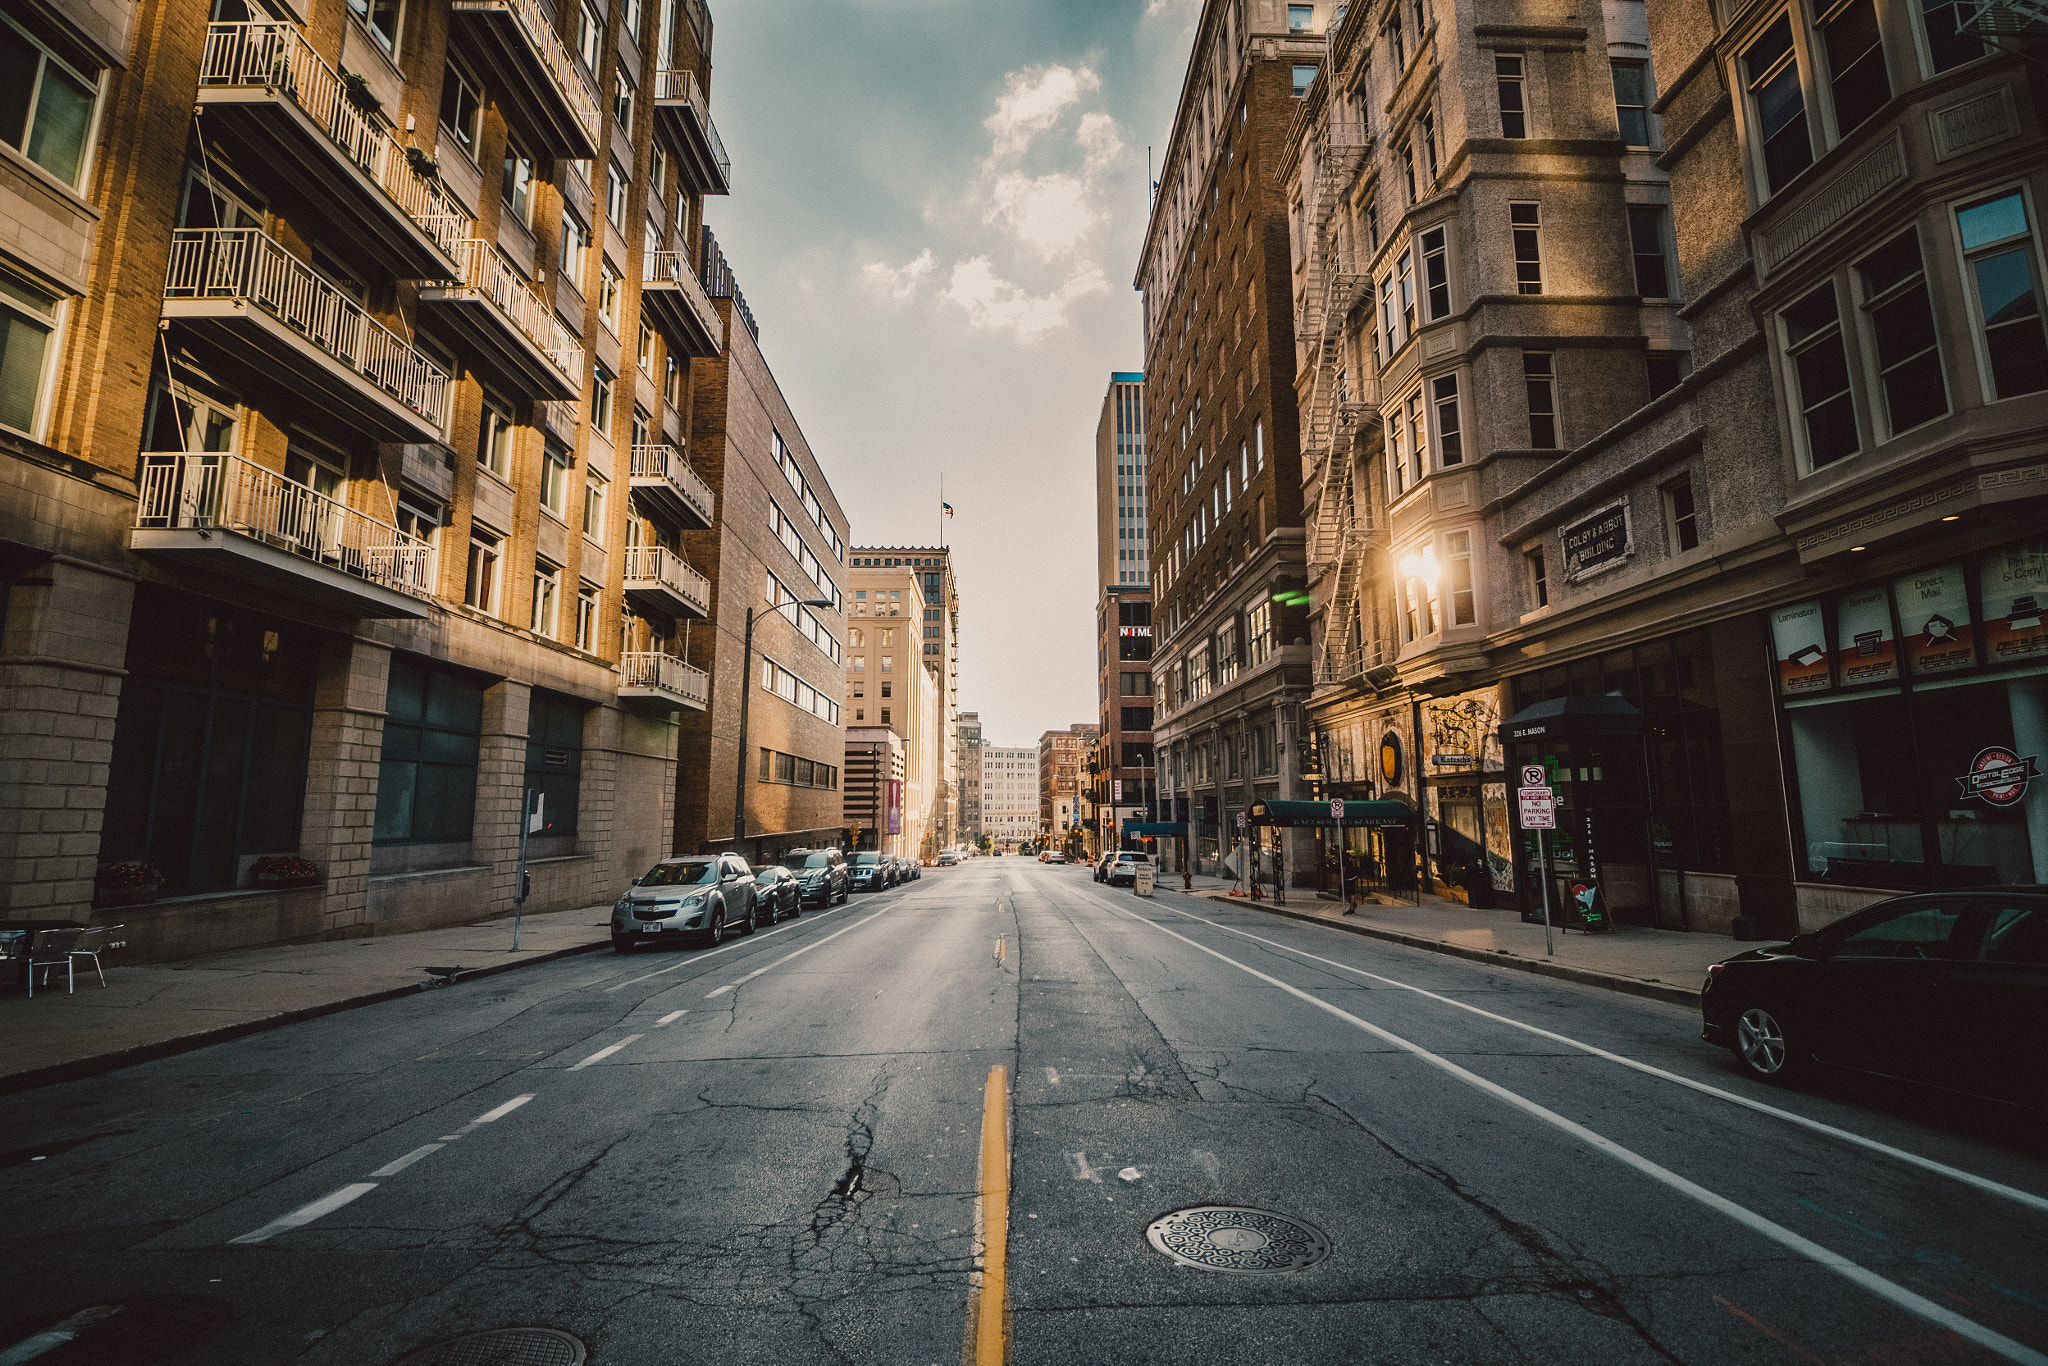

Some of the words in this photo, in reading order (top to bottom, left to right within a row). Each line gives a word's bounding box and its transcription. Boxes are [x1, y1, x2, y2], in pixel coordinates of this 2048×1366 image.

[1568, 530, 1591, 550] COLBY
[1592, 527, 1598, 538] &
[1598, 514, 1624, 535] ABBOT
[1578, 538, 1615, 562] BUILDING
[2002, 572, 2013, 582] &
[2014, 566, 2043, 579] Copy
[1915, 576, 1945, 590] Direct
[1920, 587, 1941, 600] Mail
[1778, 608, 1817, 623] Lamination
[1513, 730, 1523, 738] 326
[1527, 726, 1546, 736] MASON
[1588, 848, 1597, 879] MASON
